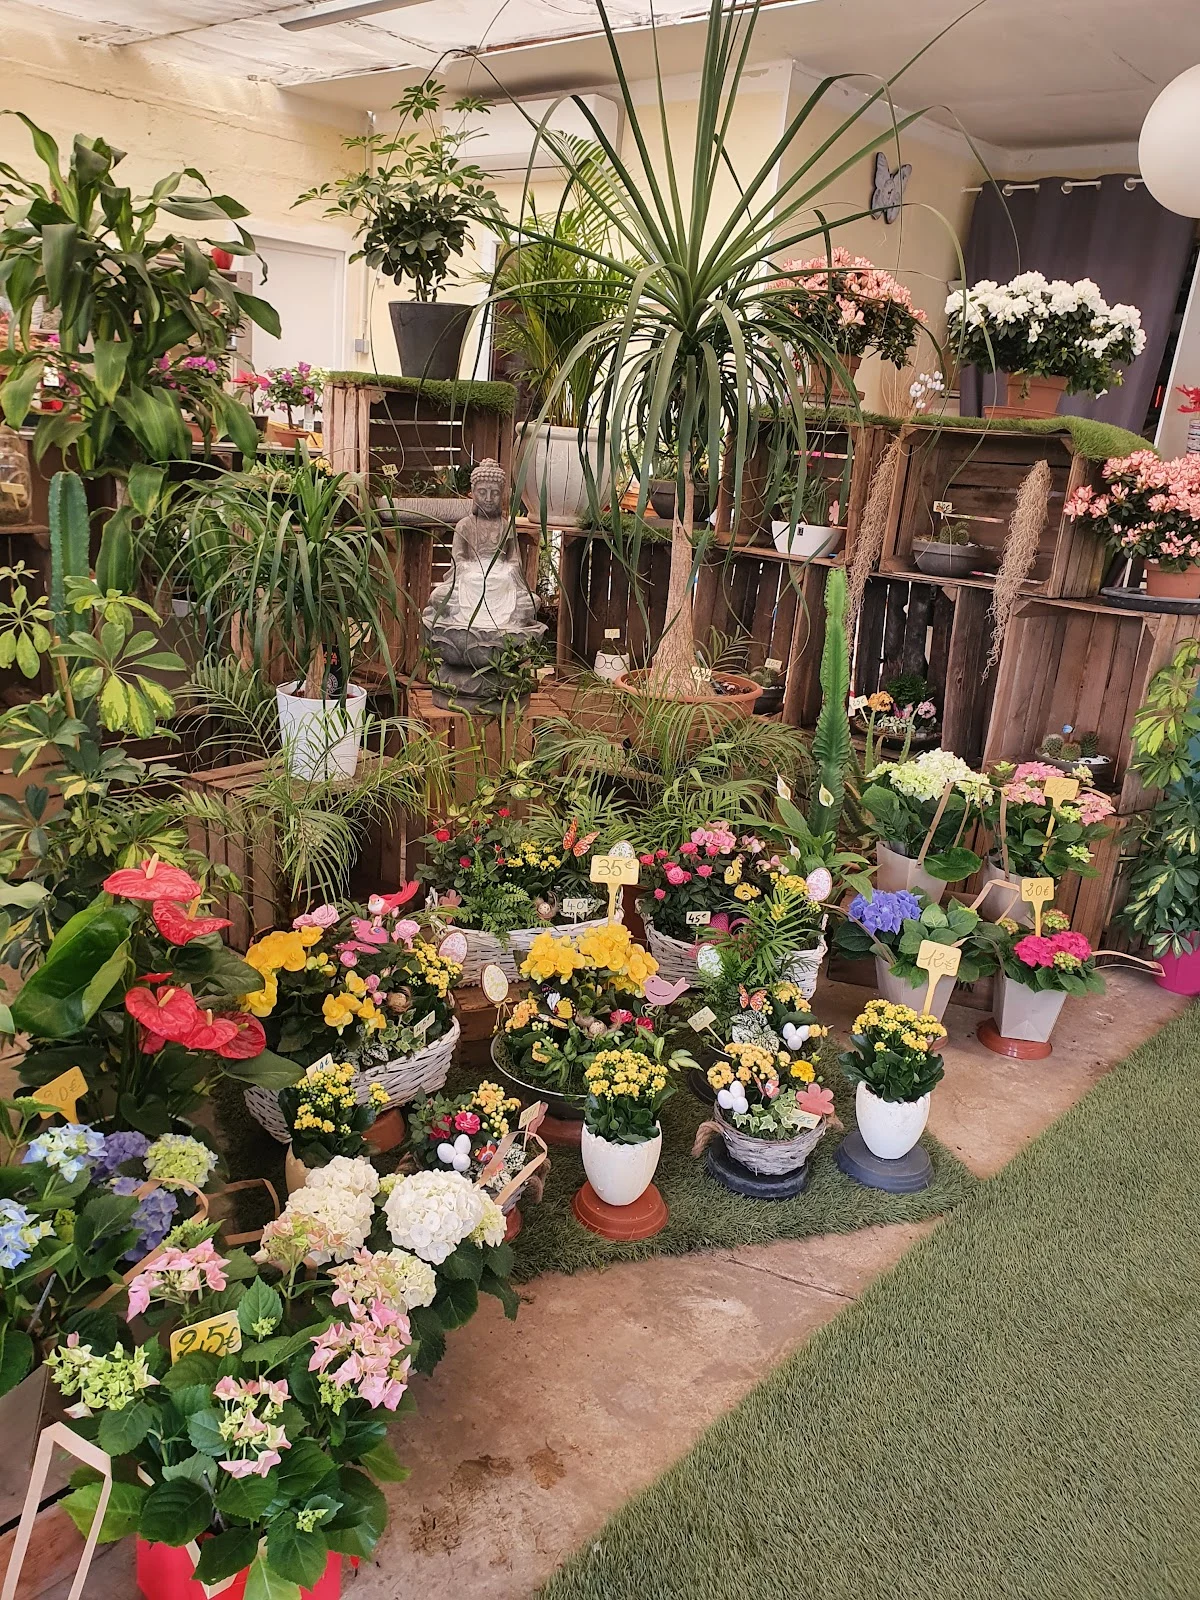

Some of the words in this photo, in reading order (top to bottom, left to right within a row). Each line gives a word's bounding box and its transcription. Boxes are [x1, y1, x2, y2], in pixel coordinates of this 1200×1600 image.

[597, 858, 635, 877] 35€
[1025, 882, 1050, 897] 20€
[566, 899, 587, 911] 40€
[688, 912, 707, 923] 45€
[919, 949, 957, 971] 12€
